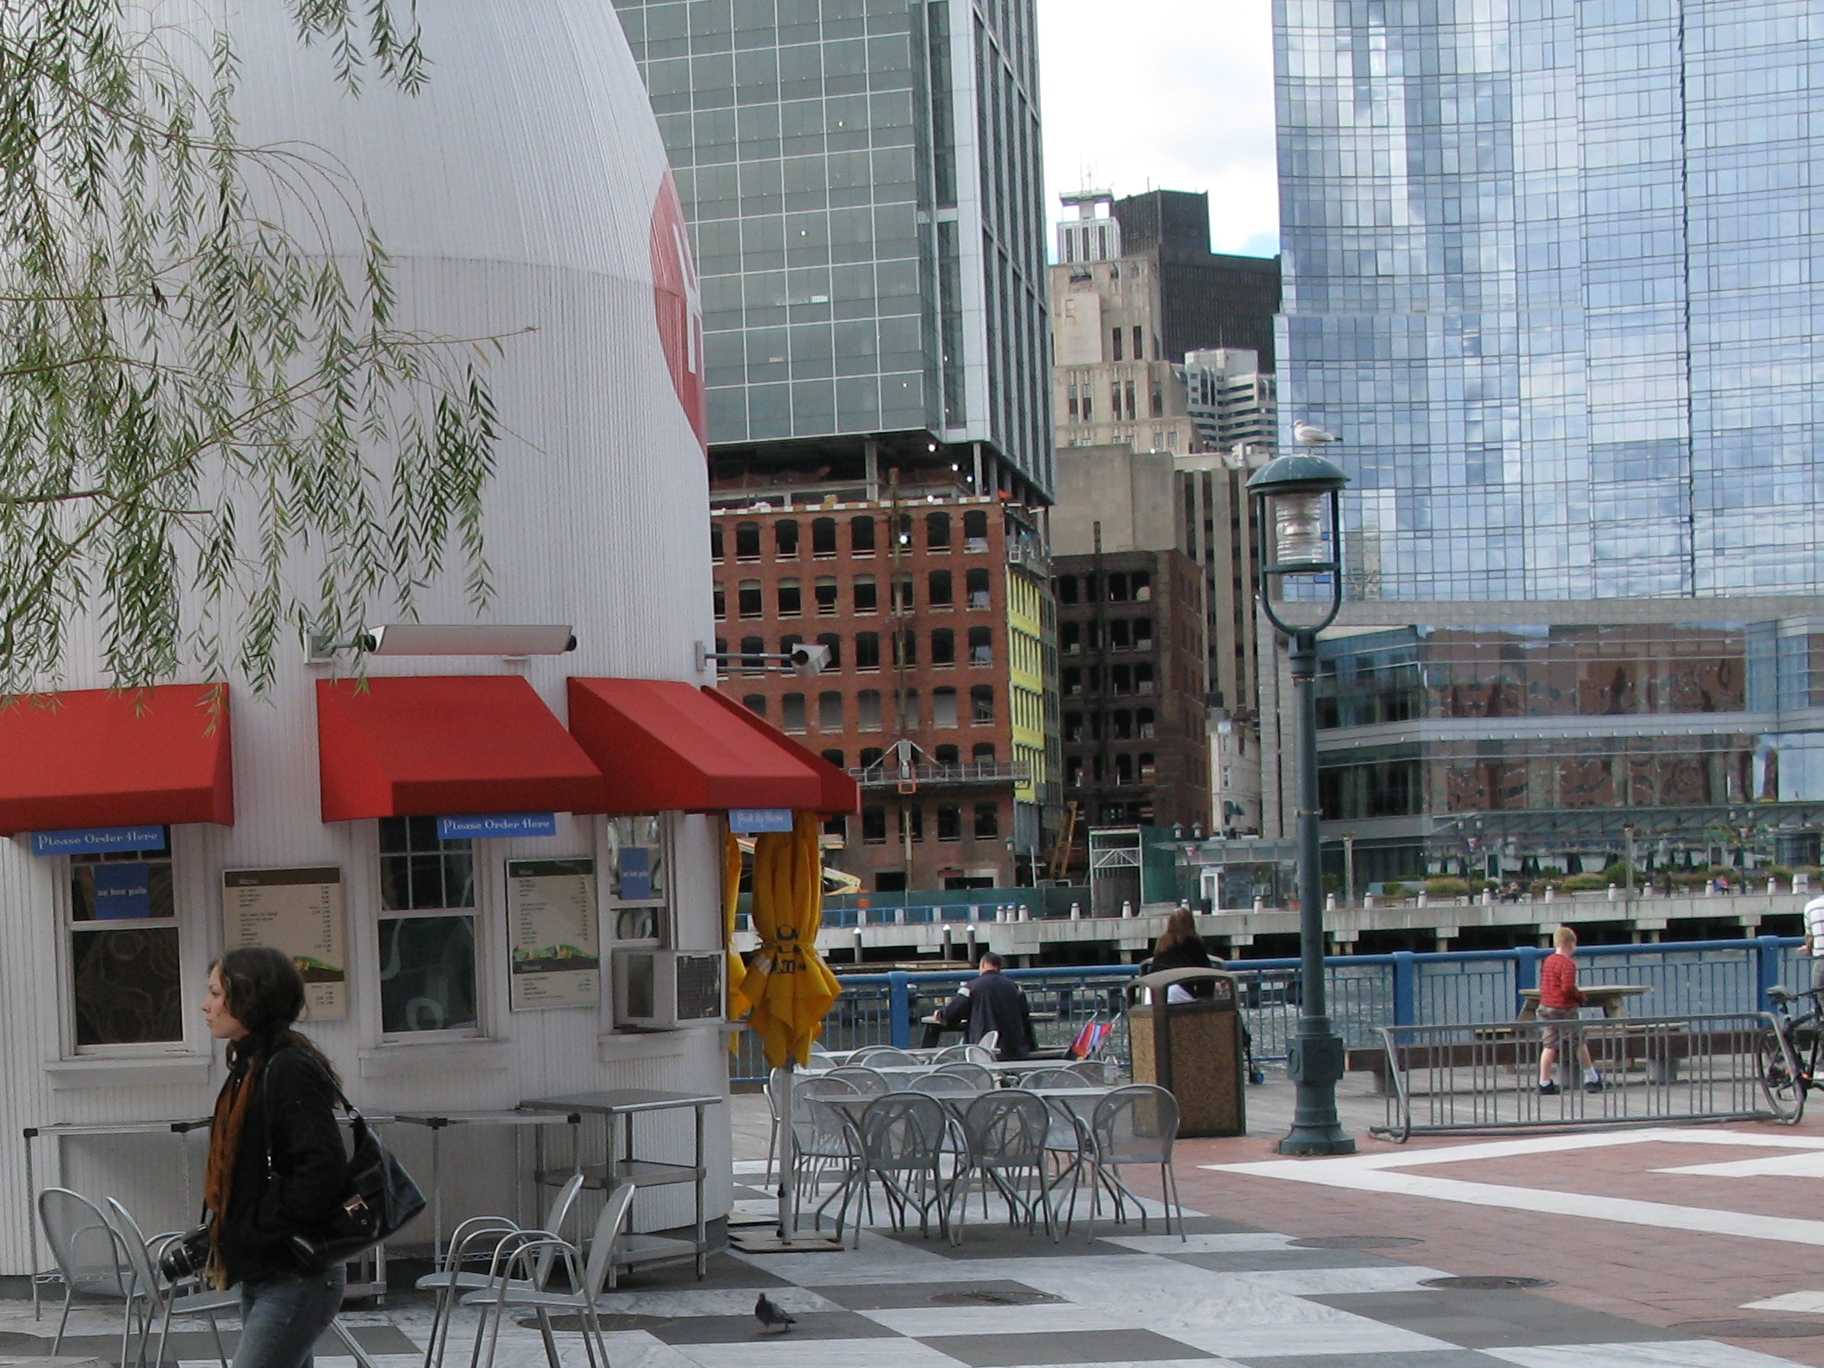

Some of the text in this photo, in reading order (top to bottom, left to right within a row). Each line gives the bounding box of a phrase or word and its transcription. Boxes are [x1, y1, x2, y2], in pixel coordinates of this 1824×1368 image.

[443, 818, 550, 834] Please Order Here
[38, 830, 158, 850] Please Order Here
